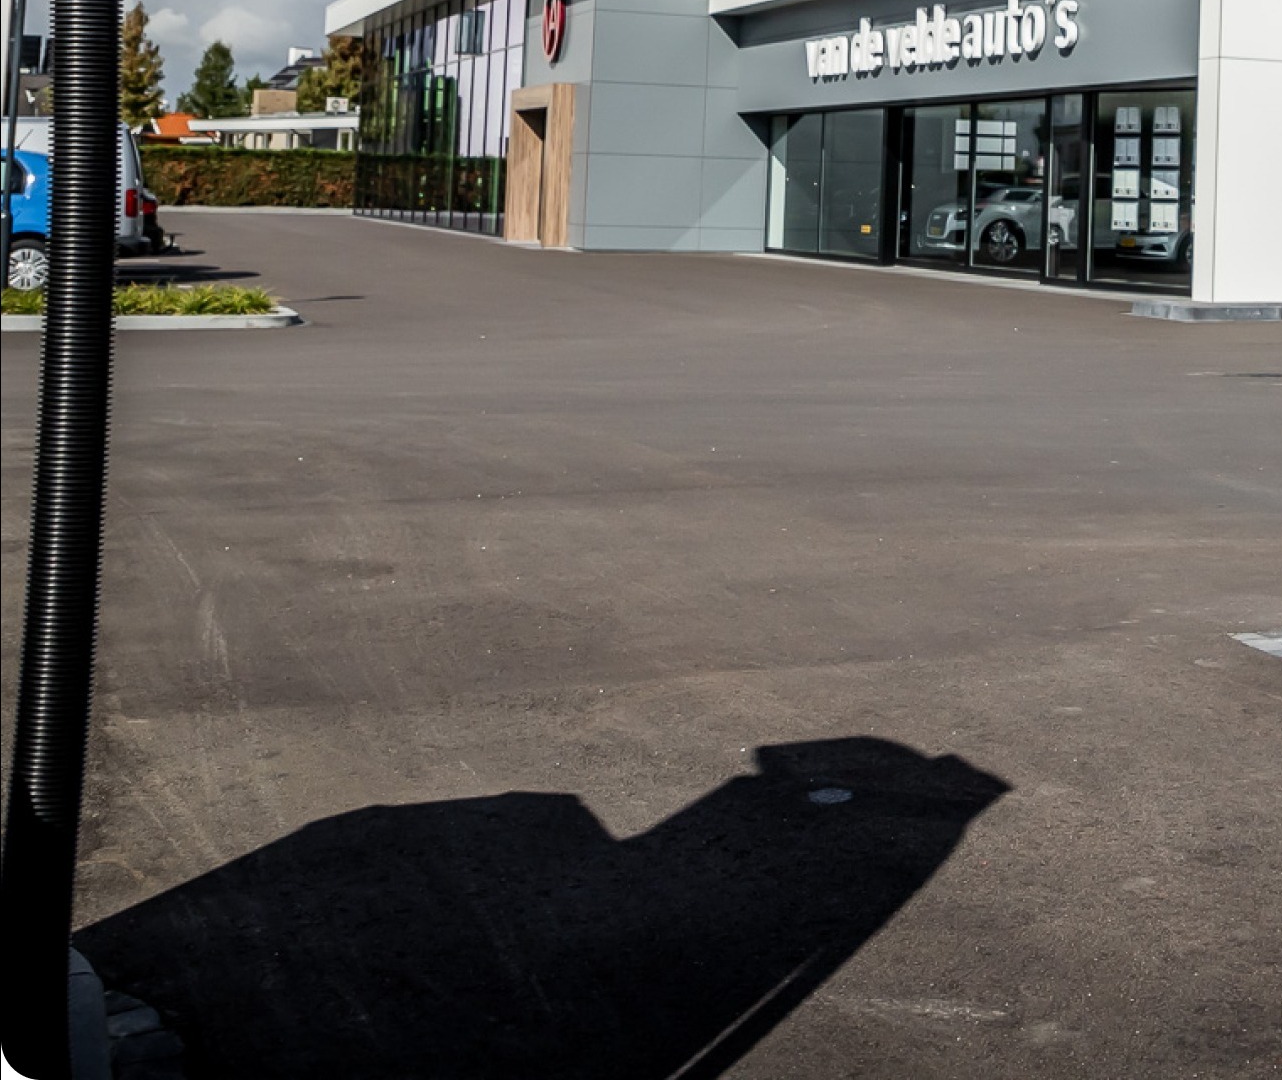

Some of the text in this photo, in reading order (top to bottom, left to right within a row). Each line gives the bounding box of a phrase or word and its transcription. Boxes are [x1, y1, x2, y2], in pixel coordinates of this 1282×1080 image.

[805, 36, 849, 77] van
[851, 17, 884, 72] de
[886, 4, 961, 68] velde
